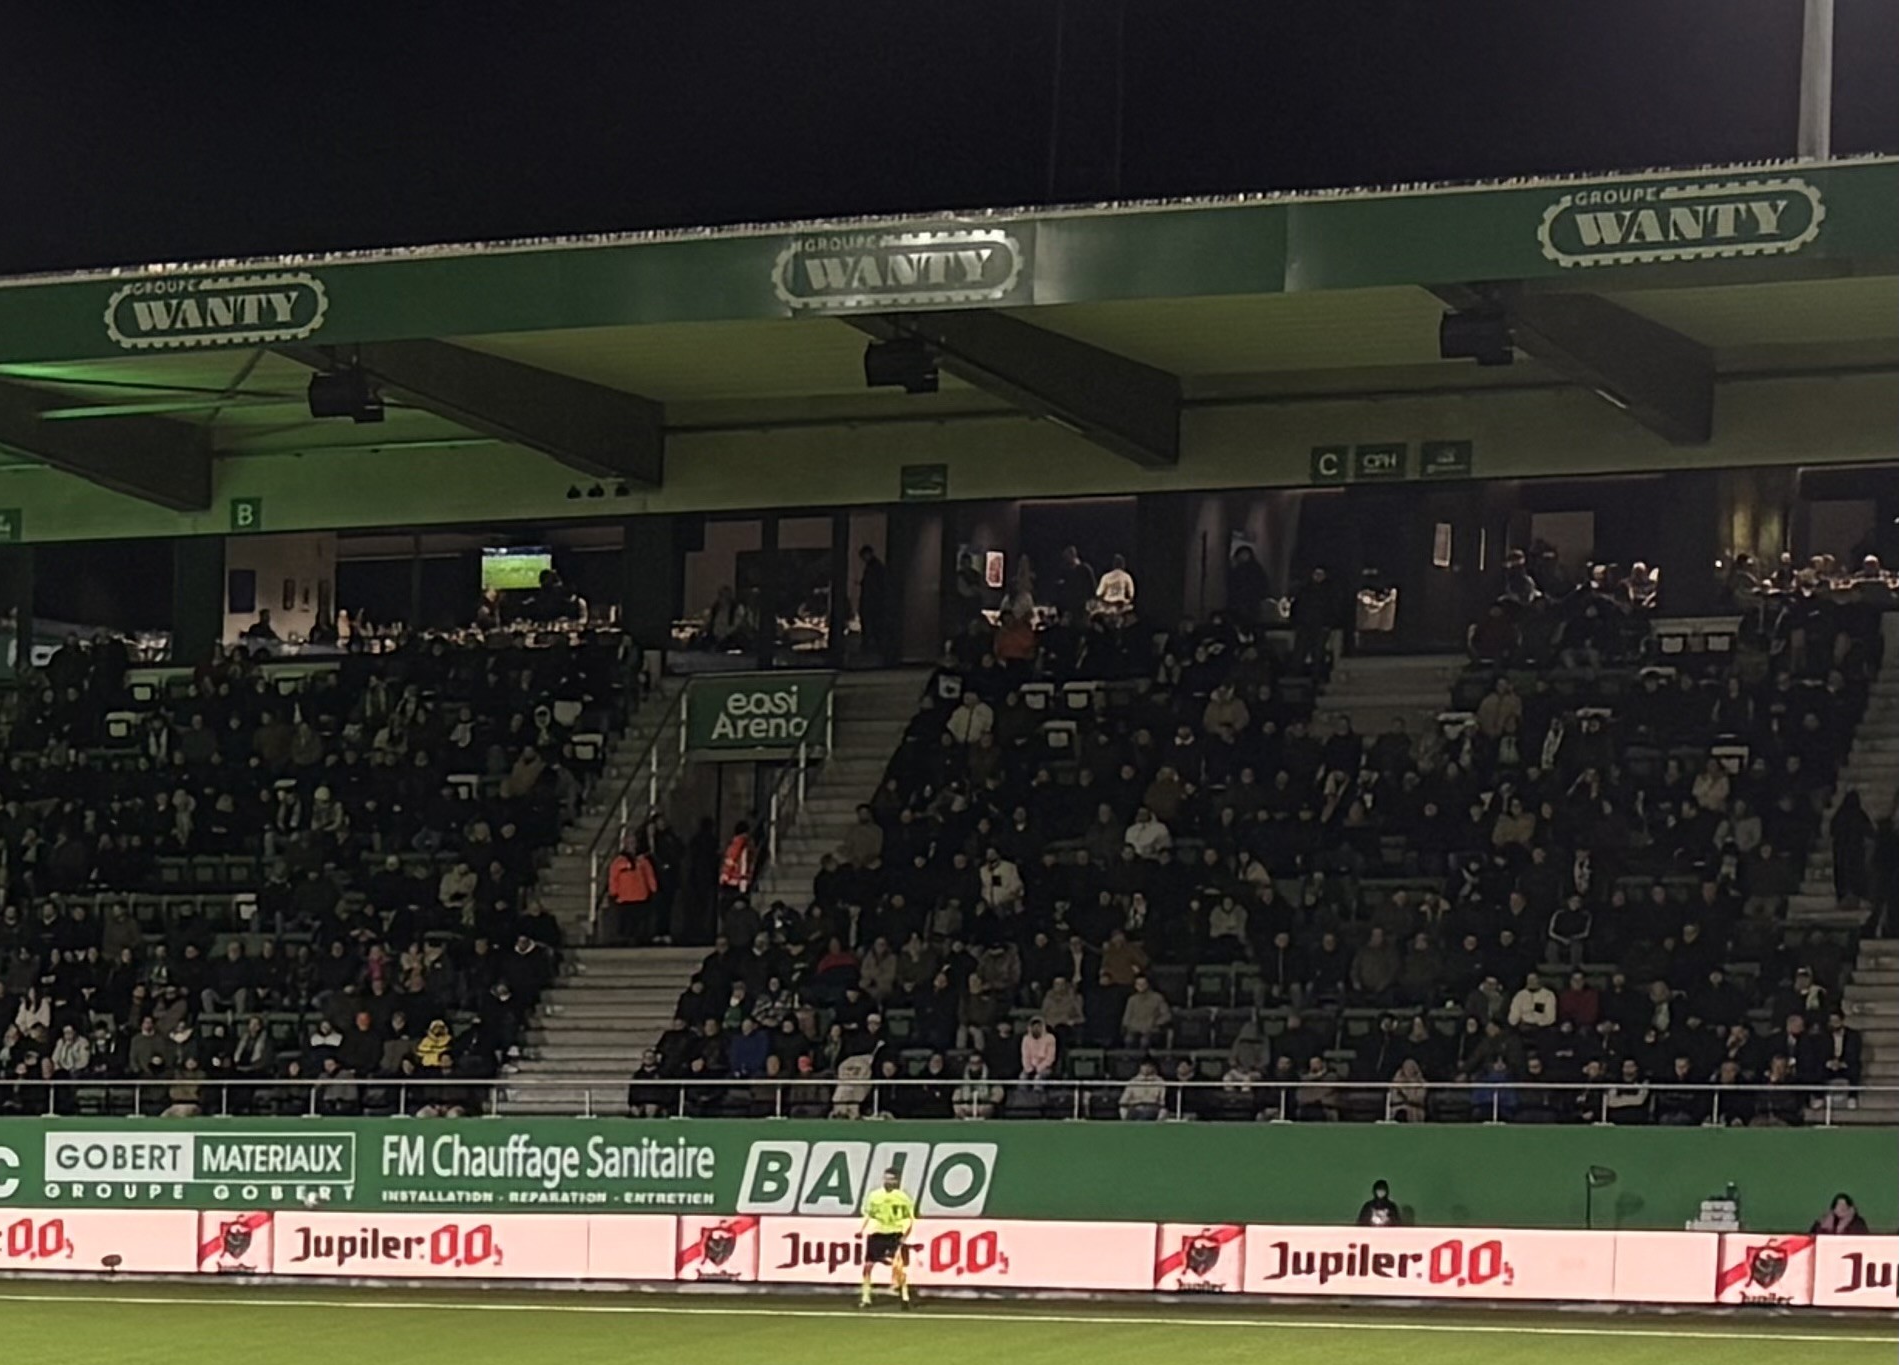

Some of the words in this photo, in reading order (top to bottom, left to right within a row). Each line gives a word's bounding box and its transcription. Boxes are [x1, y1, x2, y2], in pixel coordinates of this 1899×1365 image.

[1575, 187, 1660, 206] GROUPE
[1574, 200, 1788, 247] WANTY
[804, 248, 993, 291] WANTY
[133, 291, 300, 331] WANTY
[1319, 453, 1338, 476] C
[236, 502, 254, 526] B
[726, 685, 799, 716] easi
[710, 712, 808, 740] Arena
[55, 1143, 182, 1173] GOBERT
[202, 1143, 344, 1174] MATERIAUX
[382, 1134, 425, 1177] FM
[432, 1132, 581, 1188] Chauffage
[586, 1134, 715, 1179] Sanitaire
[44, 1183, 185, 1200] GROUPE
[212, 1184, 355, 1202] GOBERT
[381, 1190, 494, 1203] INSTALLATION
[508, 1190, 607, 1204] REPARATION
[623, 1191, 715, 1205] ENTRETIEN
[289, 1226, 425, 1266] Jupiler
[776, 1231, 925, 1273] Jupir
[1261, 1239, 1423, 1286] Jupiler
